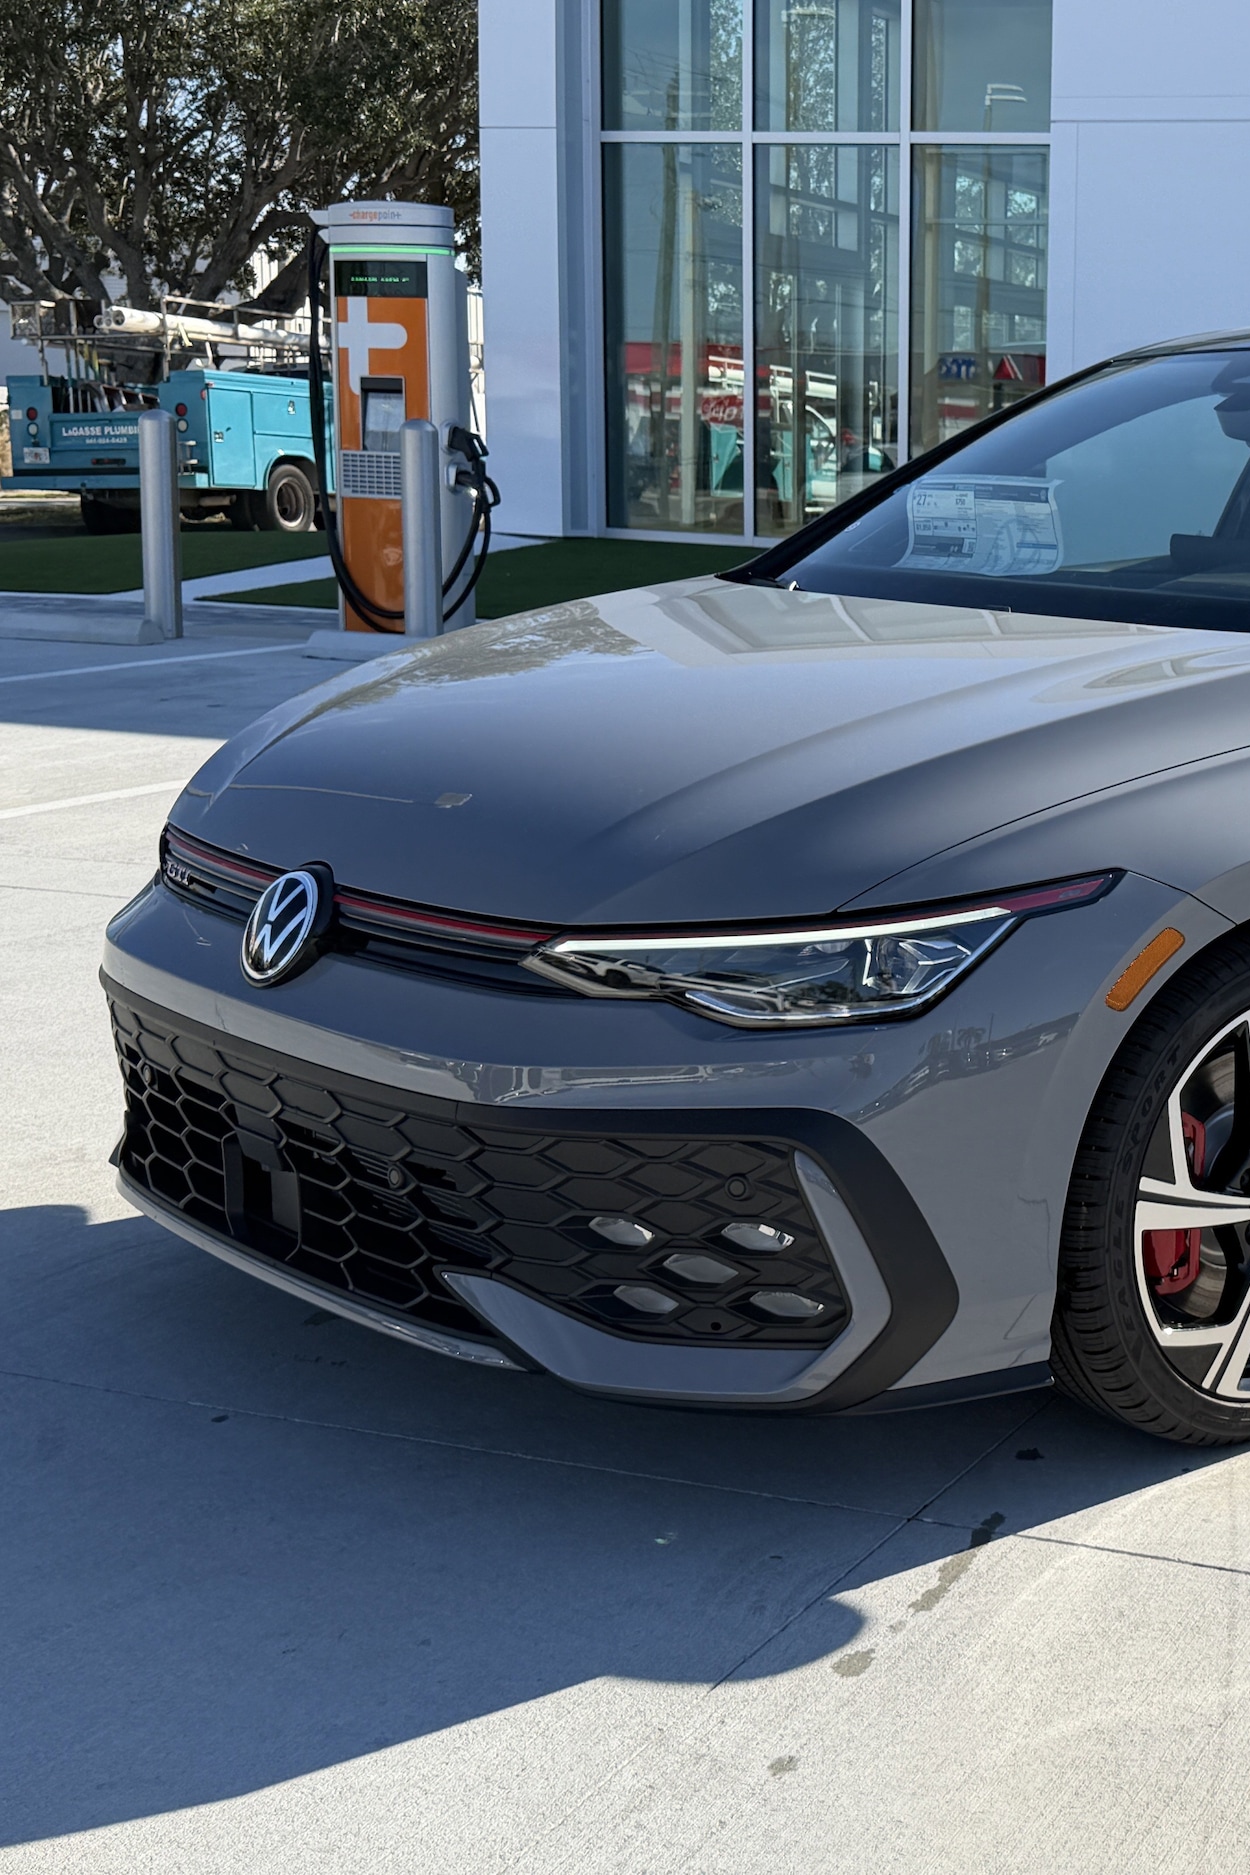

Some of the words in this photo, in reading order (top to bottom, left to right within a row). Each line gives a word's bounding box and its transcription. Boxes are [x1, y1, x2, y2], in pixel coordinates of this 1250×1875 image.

[104, 426, 139, 435] PLUMBI
[916, 494, 927, 506] 27
[166, 861, 192, 886] GTI
[1121, 1049, 1182, 1172] SPORT
[1112, 1195, 1137, 1332] EAGLE
